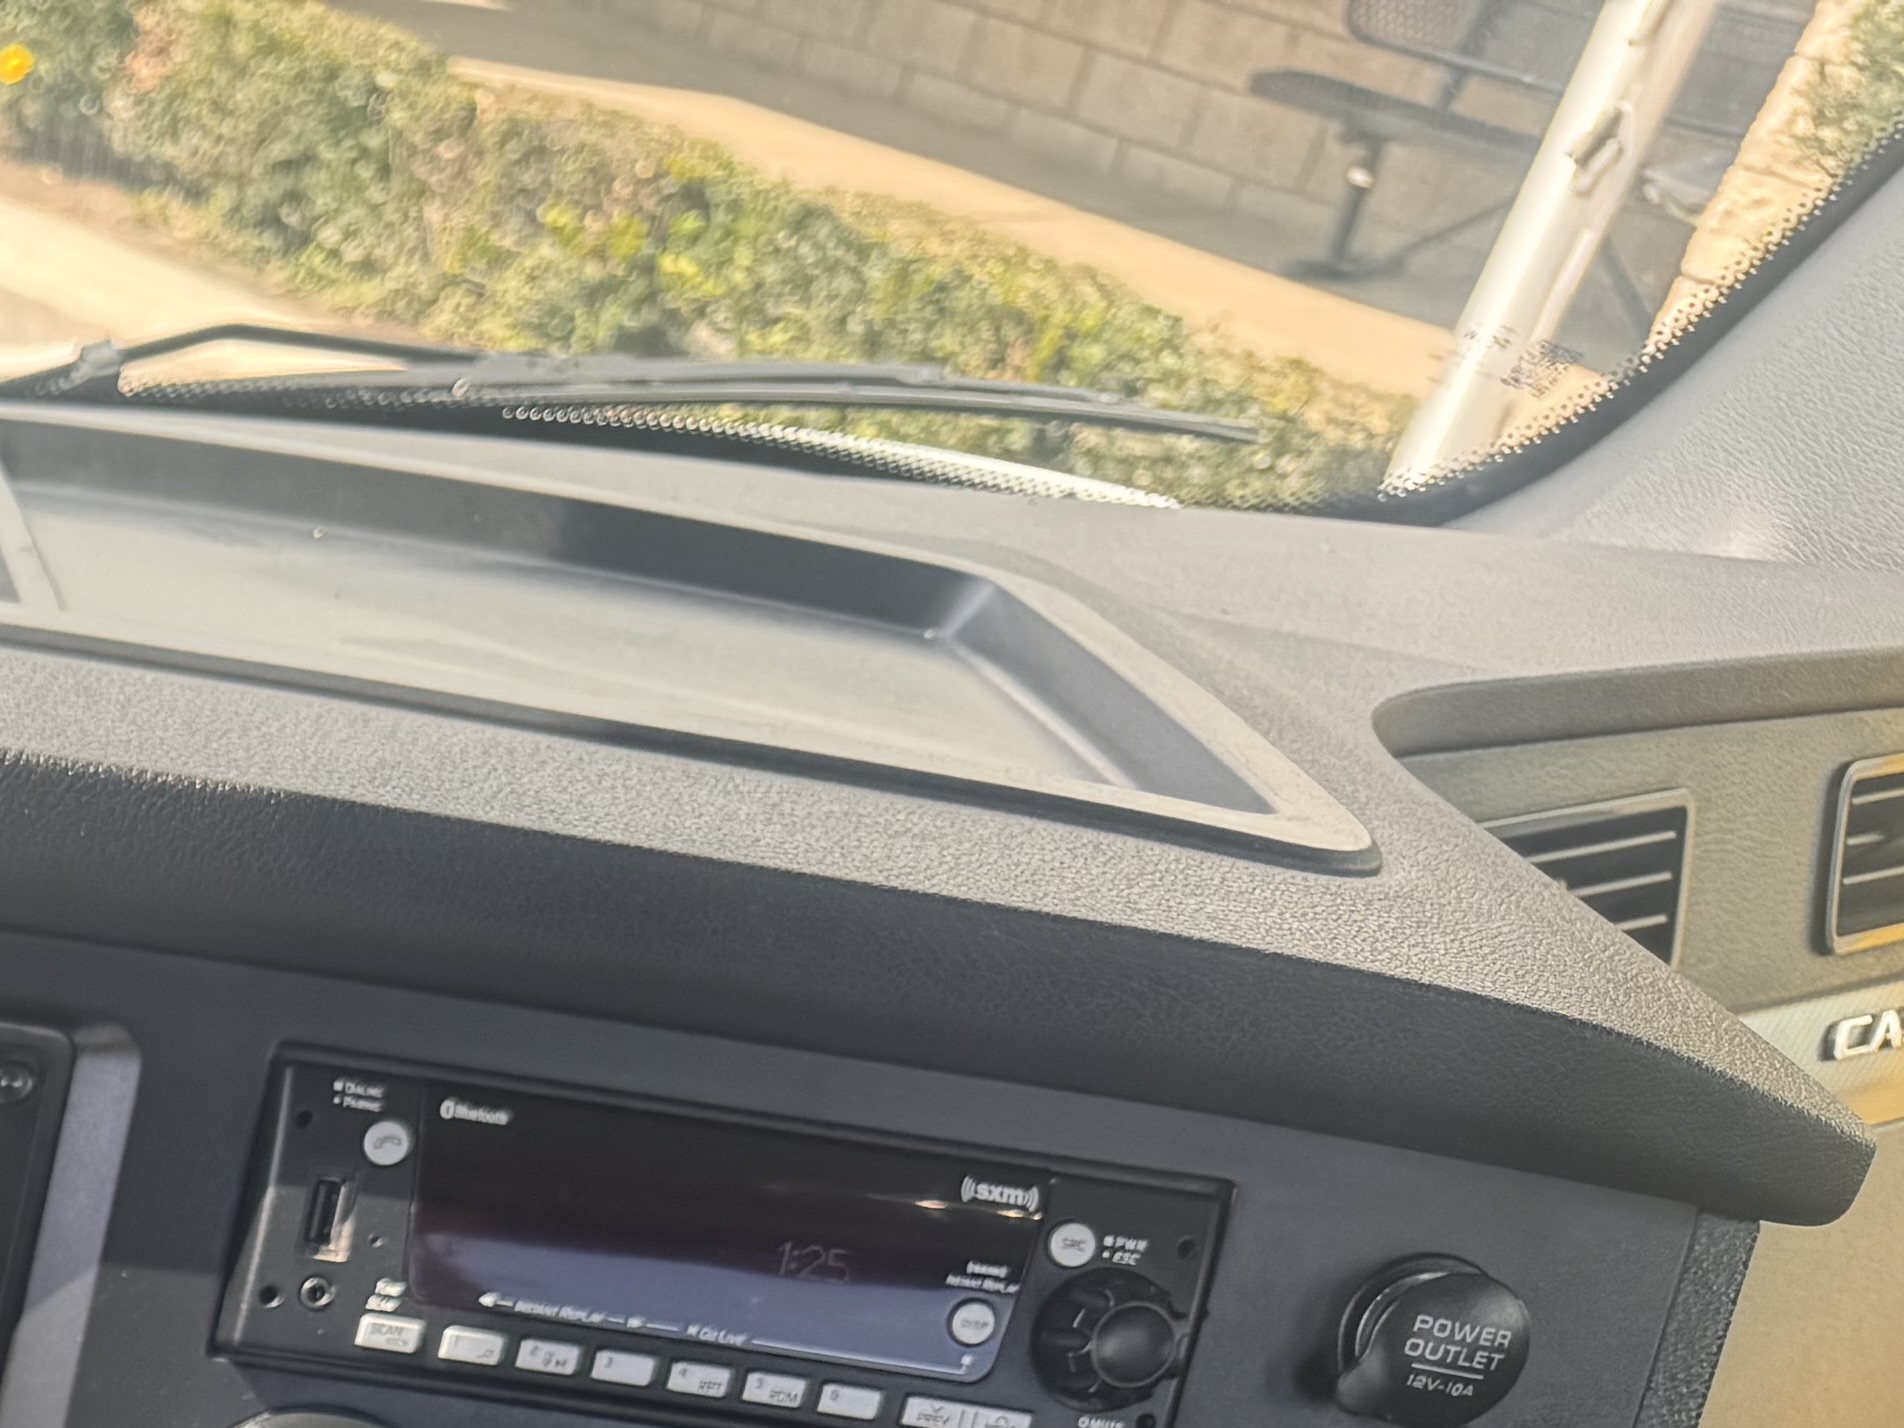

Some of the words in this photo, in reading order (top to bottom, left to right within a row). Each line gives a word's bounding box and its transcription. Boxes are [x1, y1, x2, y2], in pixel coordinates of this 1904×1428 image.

[779, 1242, 850, 1284] 1:25
[1413, 1314, 1512, 1349] POWER
[1404, 1338, 1505, 1371] OUTLET
[1406, 1374, 1474, 1397] 12V-10A
